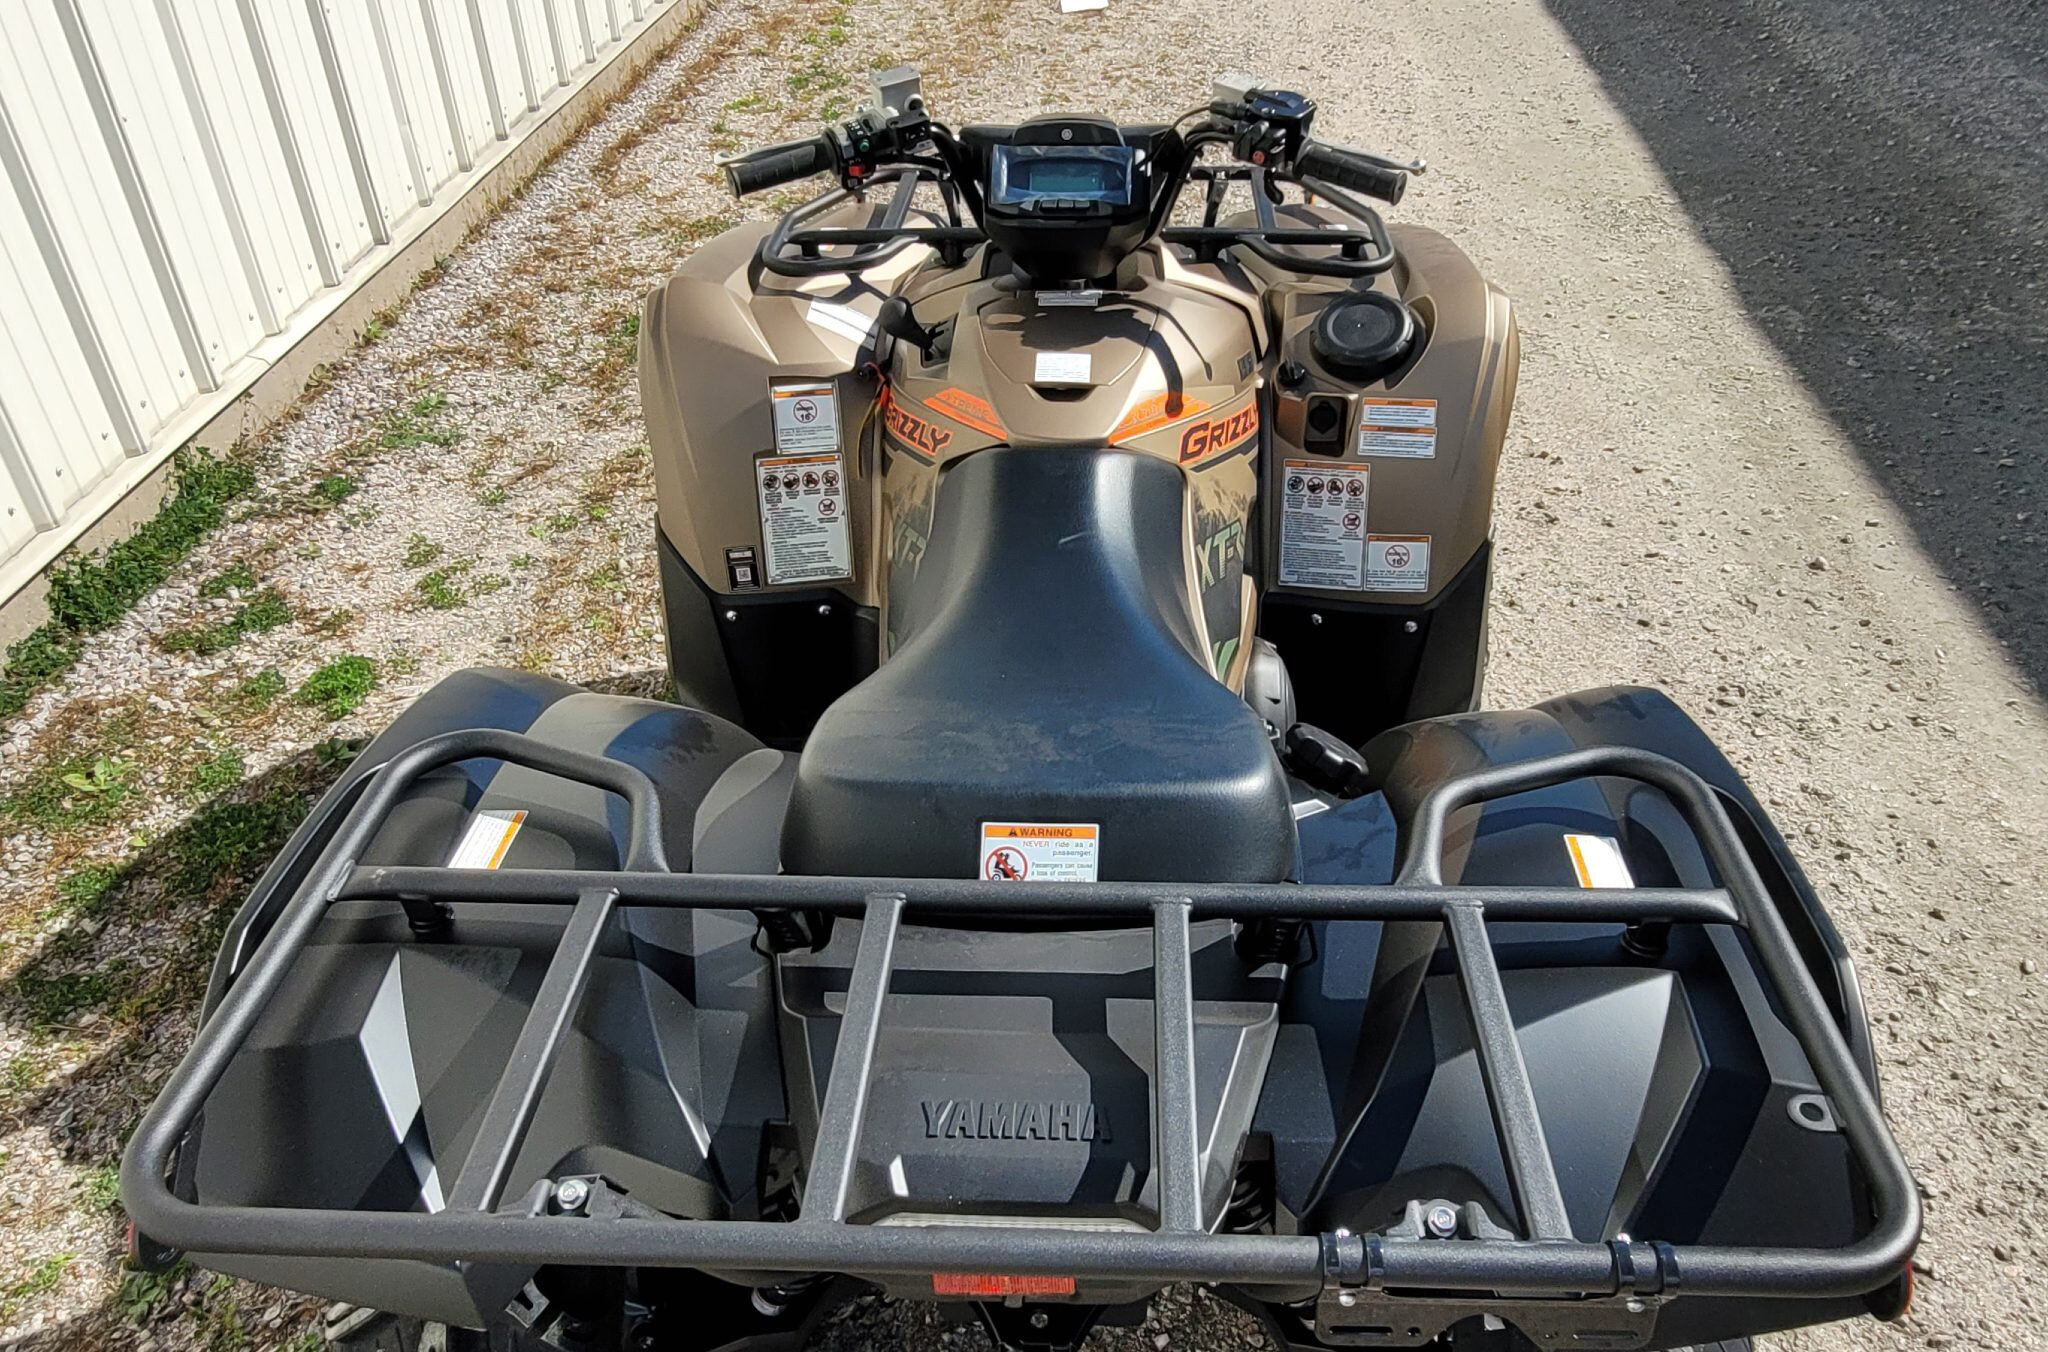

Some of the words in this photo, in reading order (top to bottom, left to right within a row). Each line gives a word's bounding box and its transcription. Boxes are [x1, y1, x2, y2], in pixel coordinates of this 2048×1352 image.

[1020, 828, 1073, 837] WARNING
[1023, 840, 1050, 848] NEVER
[921, 1100, 1112, 1142] YAMAHA
